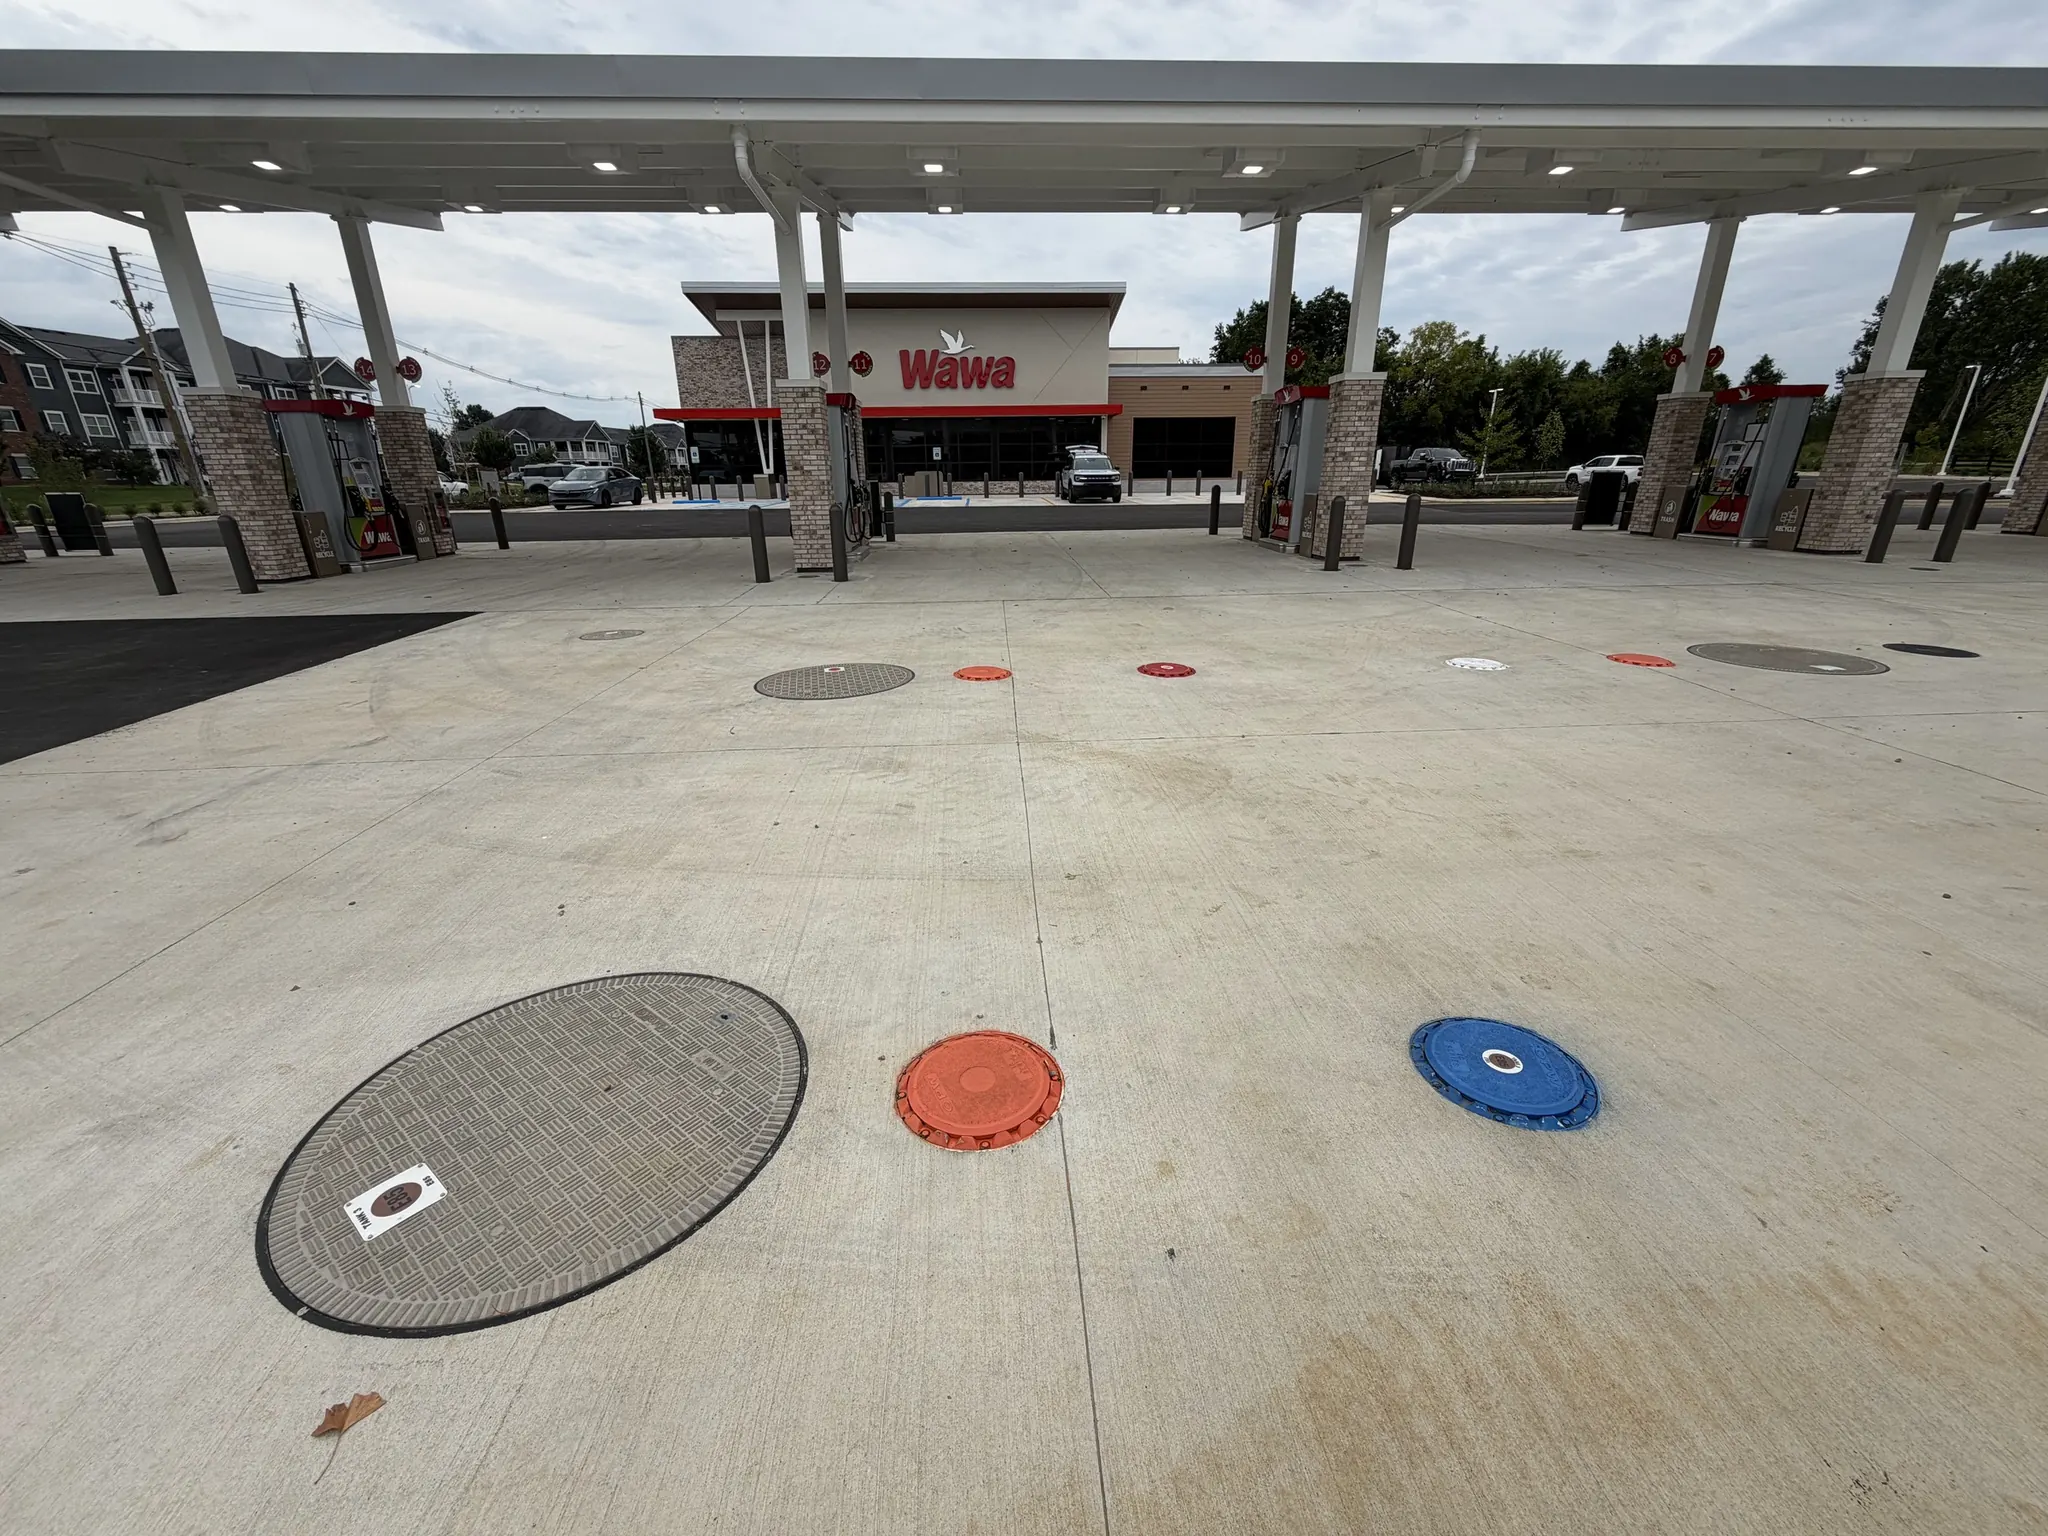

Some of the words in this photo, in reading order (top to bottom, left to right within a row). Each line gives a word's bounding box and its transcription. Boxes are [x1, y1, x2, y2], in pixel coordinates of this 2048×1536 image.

[854, 358, 867, 370] 11
[1248, 354, 1261, 365] 10
[1290, 353, 1298, 365] 9
[1669, 353, 1677, 364] 8
[1709, 352, 1717, 364] 7
[360, 364, 374, 376] 14
[402, 364, 417, 376] 13
[813, 359, 827, 370] 12
[899, 348, 1017, 390] Wawa
[422, 1175, 435, 1187] E85
[383, 1186, 412, 1212] E85
[355, 1211, 372, 1230] TANK
